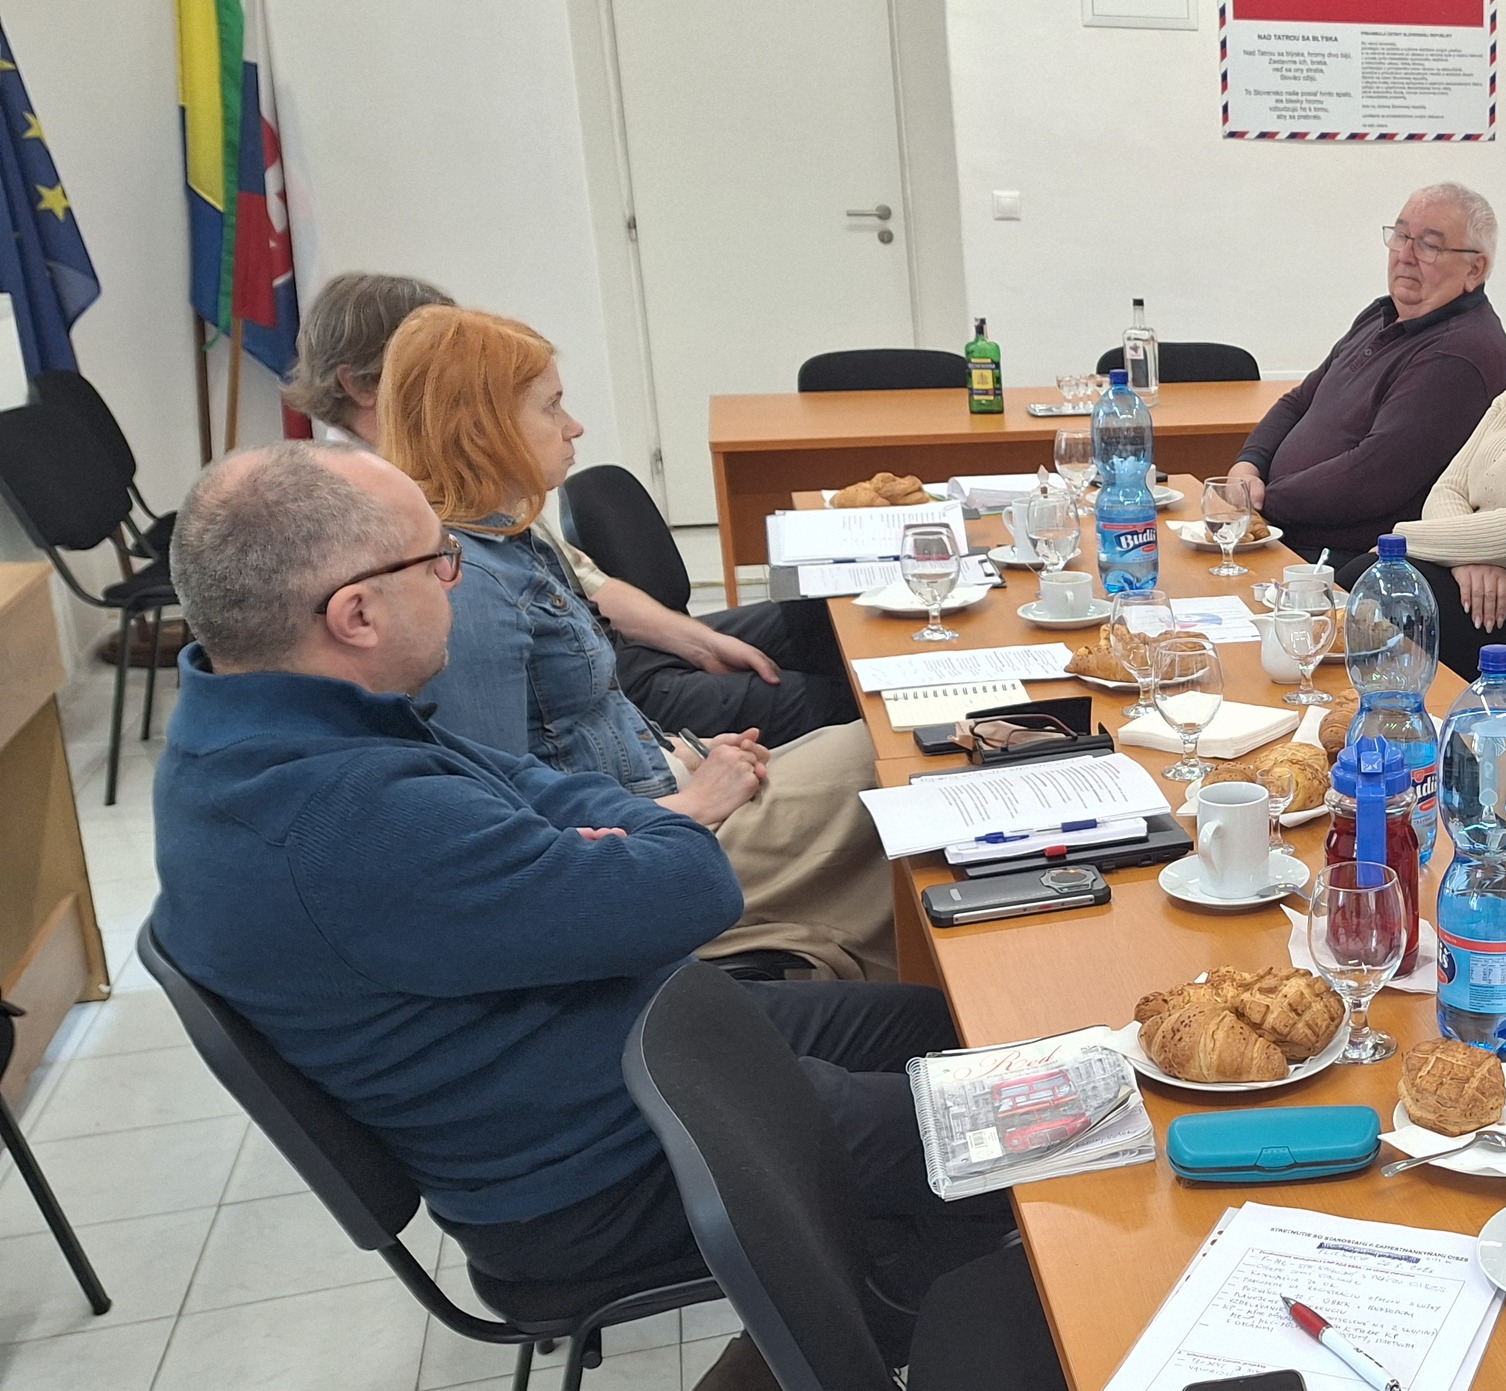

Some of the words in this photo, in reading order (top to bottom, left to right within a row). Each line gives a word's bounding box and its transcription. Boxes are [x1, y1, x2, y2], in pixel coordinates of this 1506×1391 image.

[1312, 34, 1339, 42] BLÝSKA
[1243, 49, 1256, 57] Nad
[1244, 88, 1252, 96] To
[1253, 88, 1284, 96] Slovensko
[1270, 1227, 1313, 1238] STRETNUTIE
